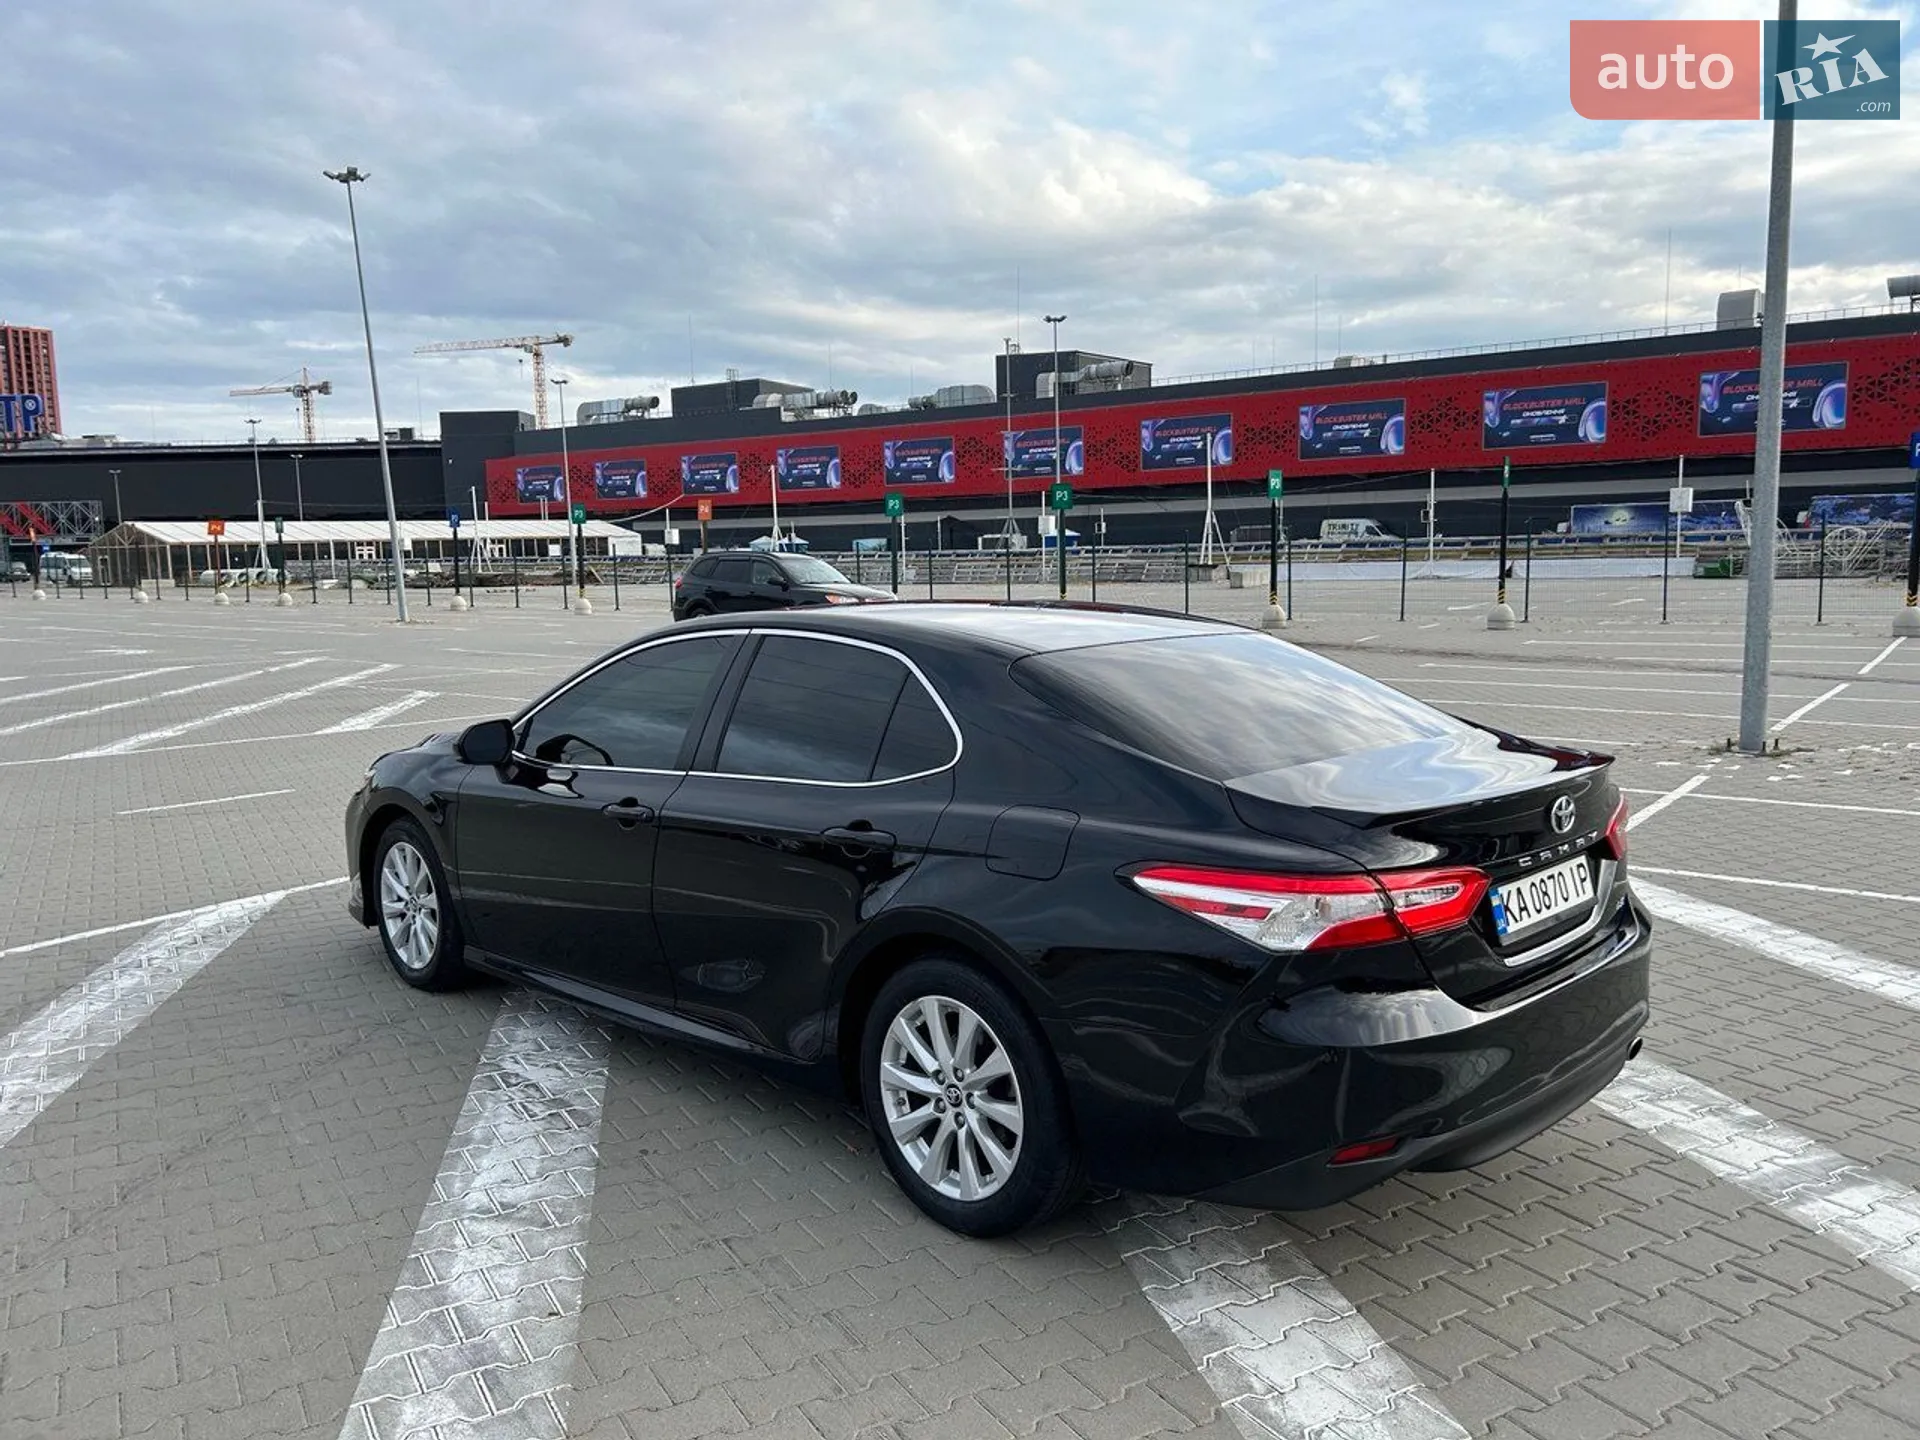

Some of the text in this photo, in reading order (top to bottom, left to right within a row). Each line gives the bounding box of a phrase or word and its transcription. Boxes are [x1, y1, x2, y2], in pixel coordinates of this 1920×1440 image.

[1270, 478, 1281, 489] P3
[1056, 490, 1068, 501] P3
[888, 499, 900, 509] P3
[1518, 830, 1598, 867] CAMRY
[1500, 862, 1588, 927] KA 0870 IP
